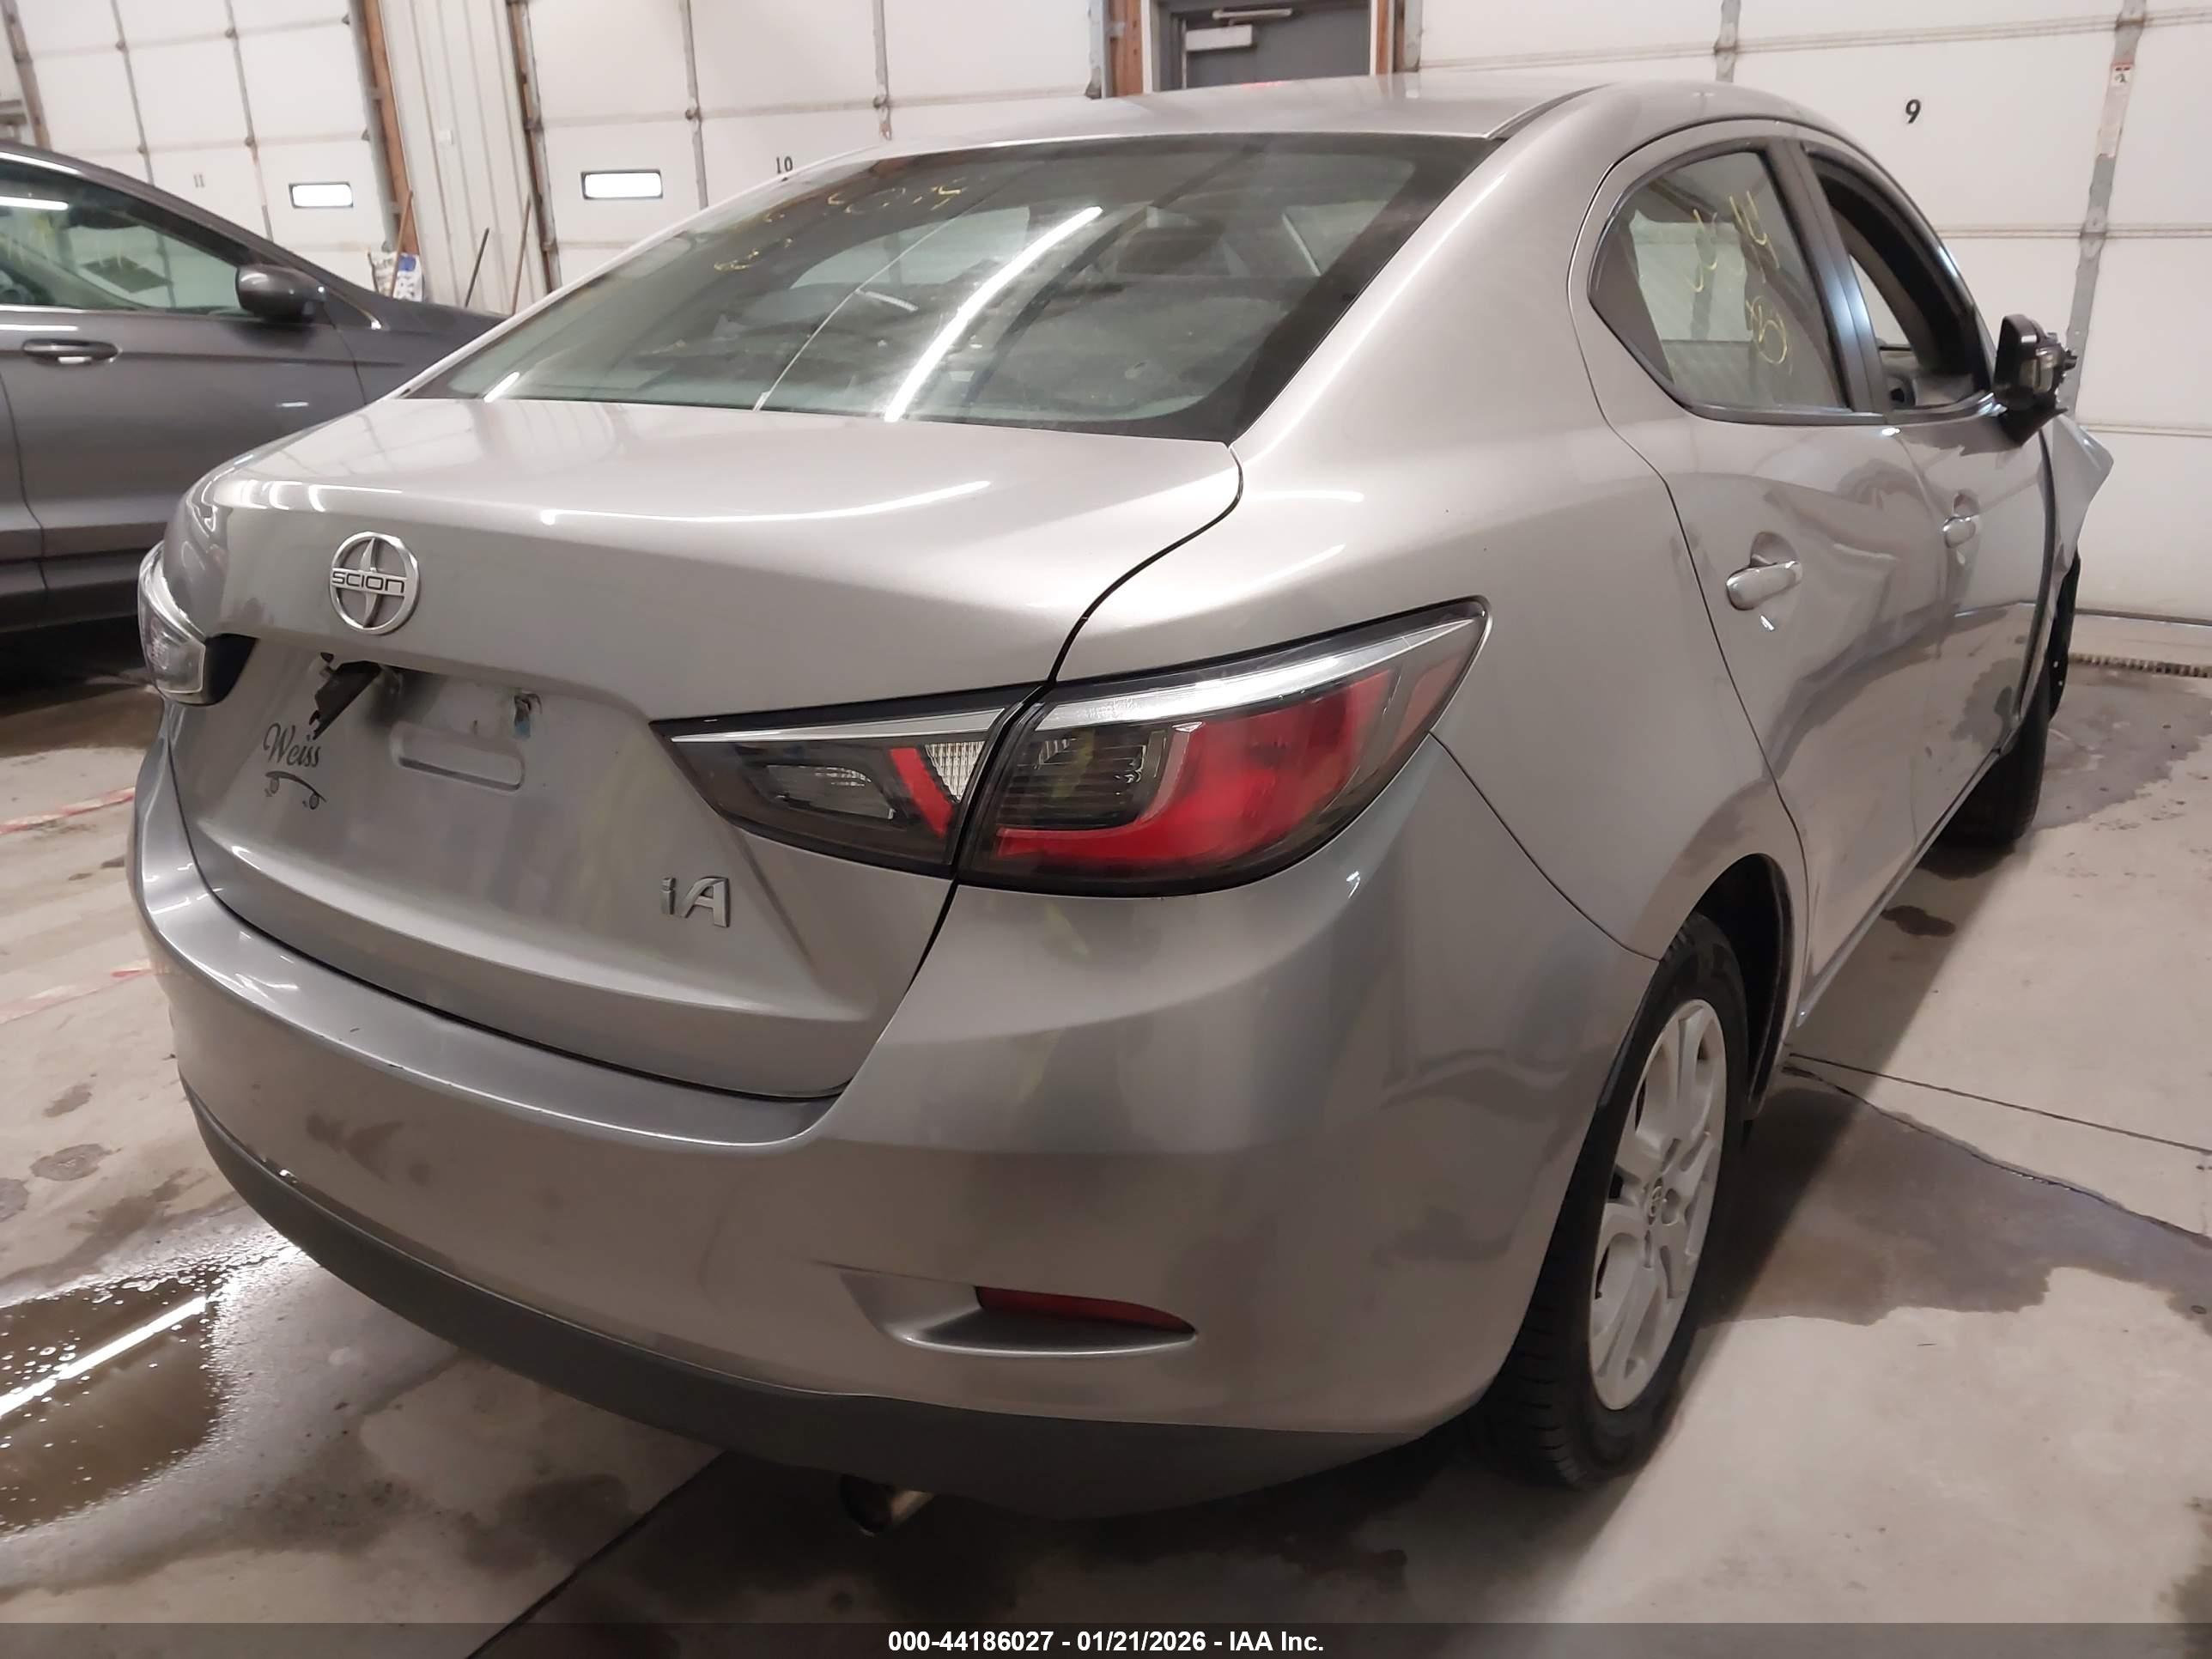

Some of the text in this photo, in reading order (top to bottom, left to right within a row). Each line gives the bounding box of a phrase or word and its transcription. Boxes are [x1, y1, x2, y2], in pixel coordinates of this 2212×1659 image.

[1905, 99, 1922, 125] 9
[776, 155, 793, 174] 10
[263, 722, 321, 768] Weiss
[660, 876, 731, 928] iA
